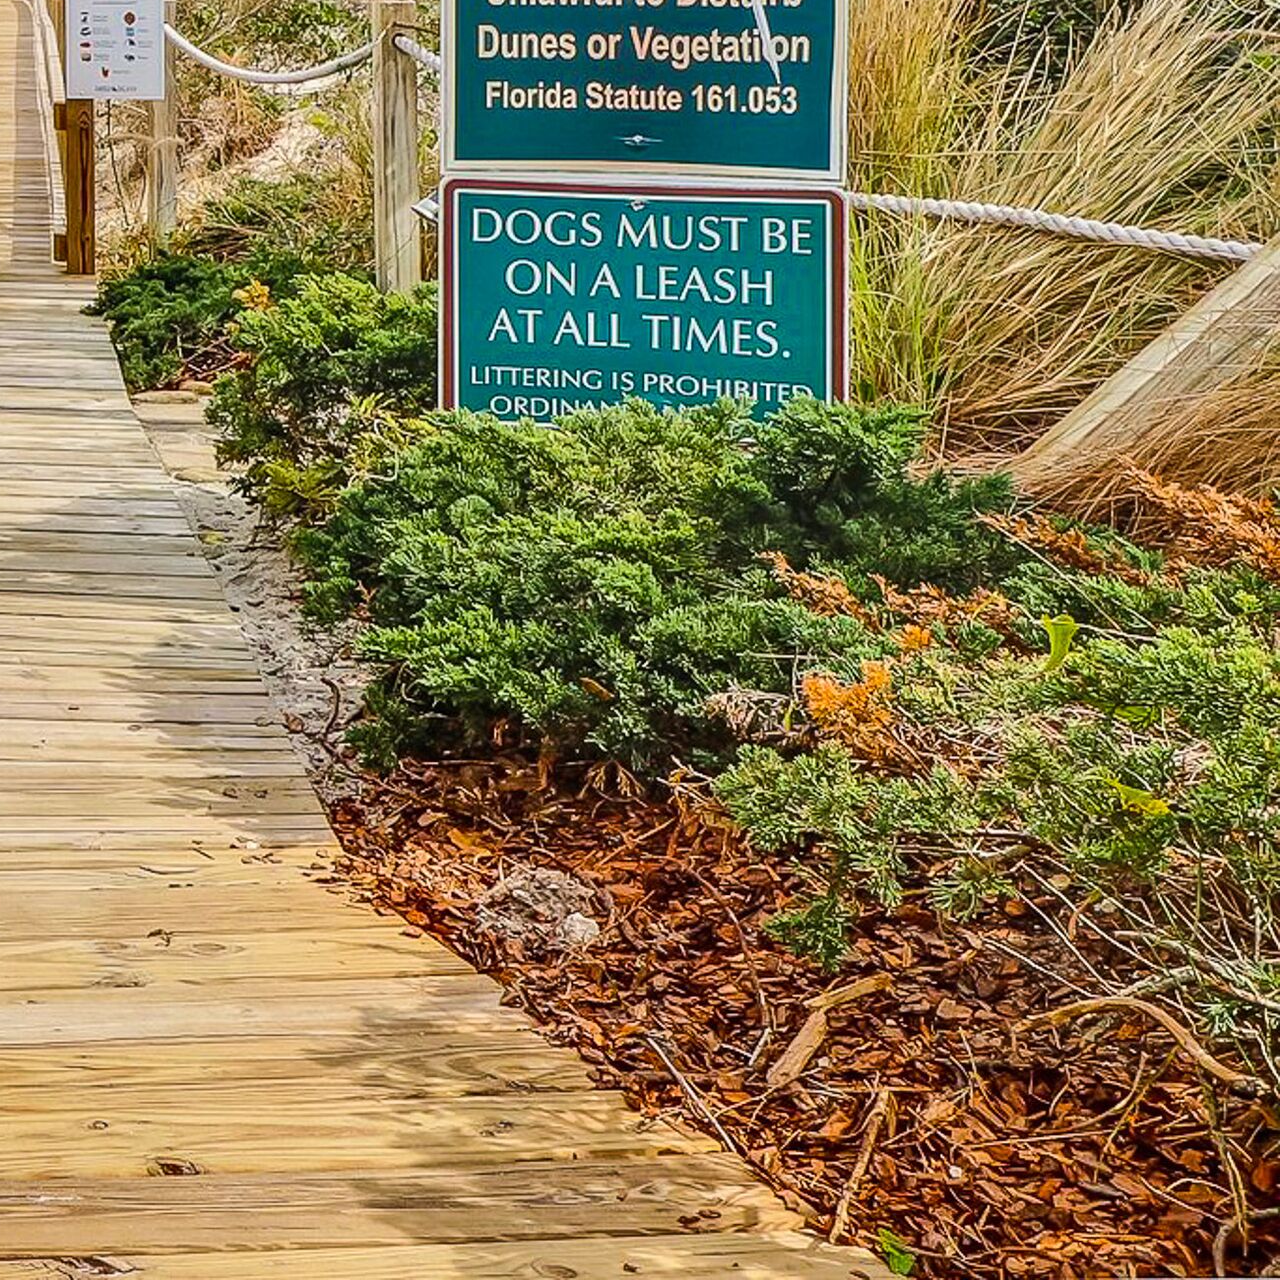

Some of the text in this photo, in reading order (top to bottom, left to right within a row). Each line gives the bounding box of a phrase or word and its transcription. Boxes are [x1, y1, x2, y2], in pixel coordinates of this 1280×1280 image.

[477, 25, 811, 70] Dunes or Vegetation
[485, 81, 798, 115] Florida Statute 161.053
[471, 208, 813, 255] DOGS MUST BE
[505, 259, 774, 306] ON A LEASH
[487, 307, 791, 359] AT ALL TIMES.
[471, 366, 813, 402] LITTERING IS PROHIBITED
